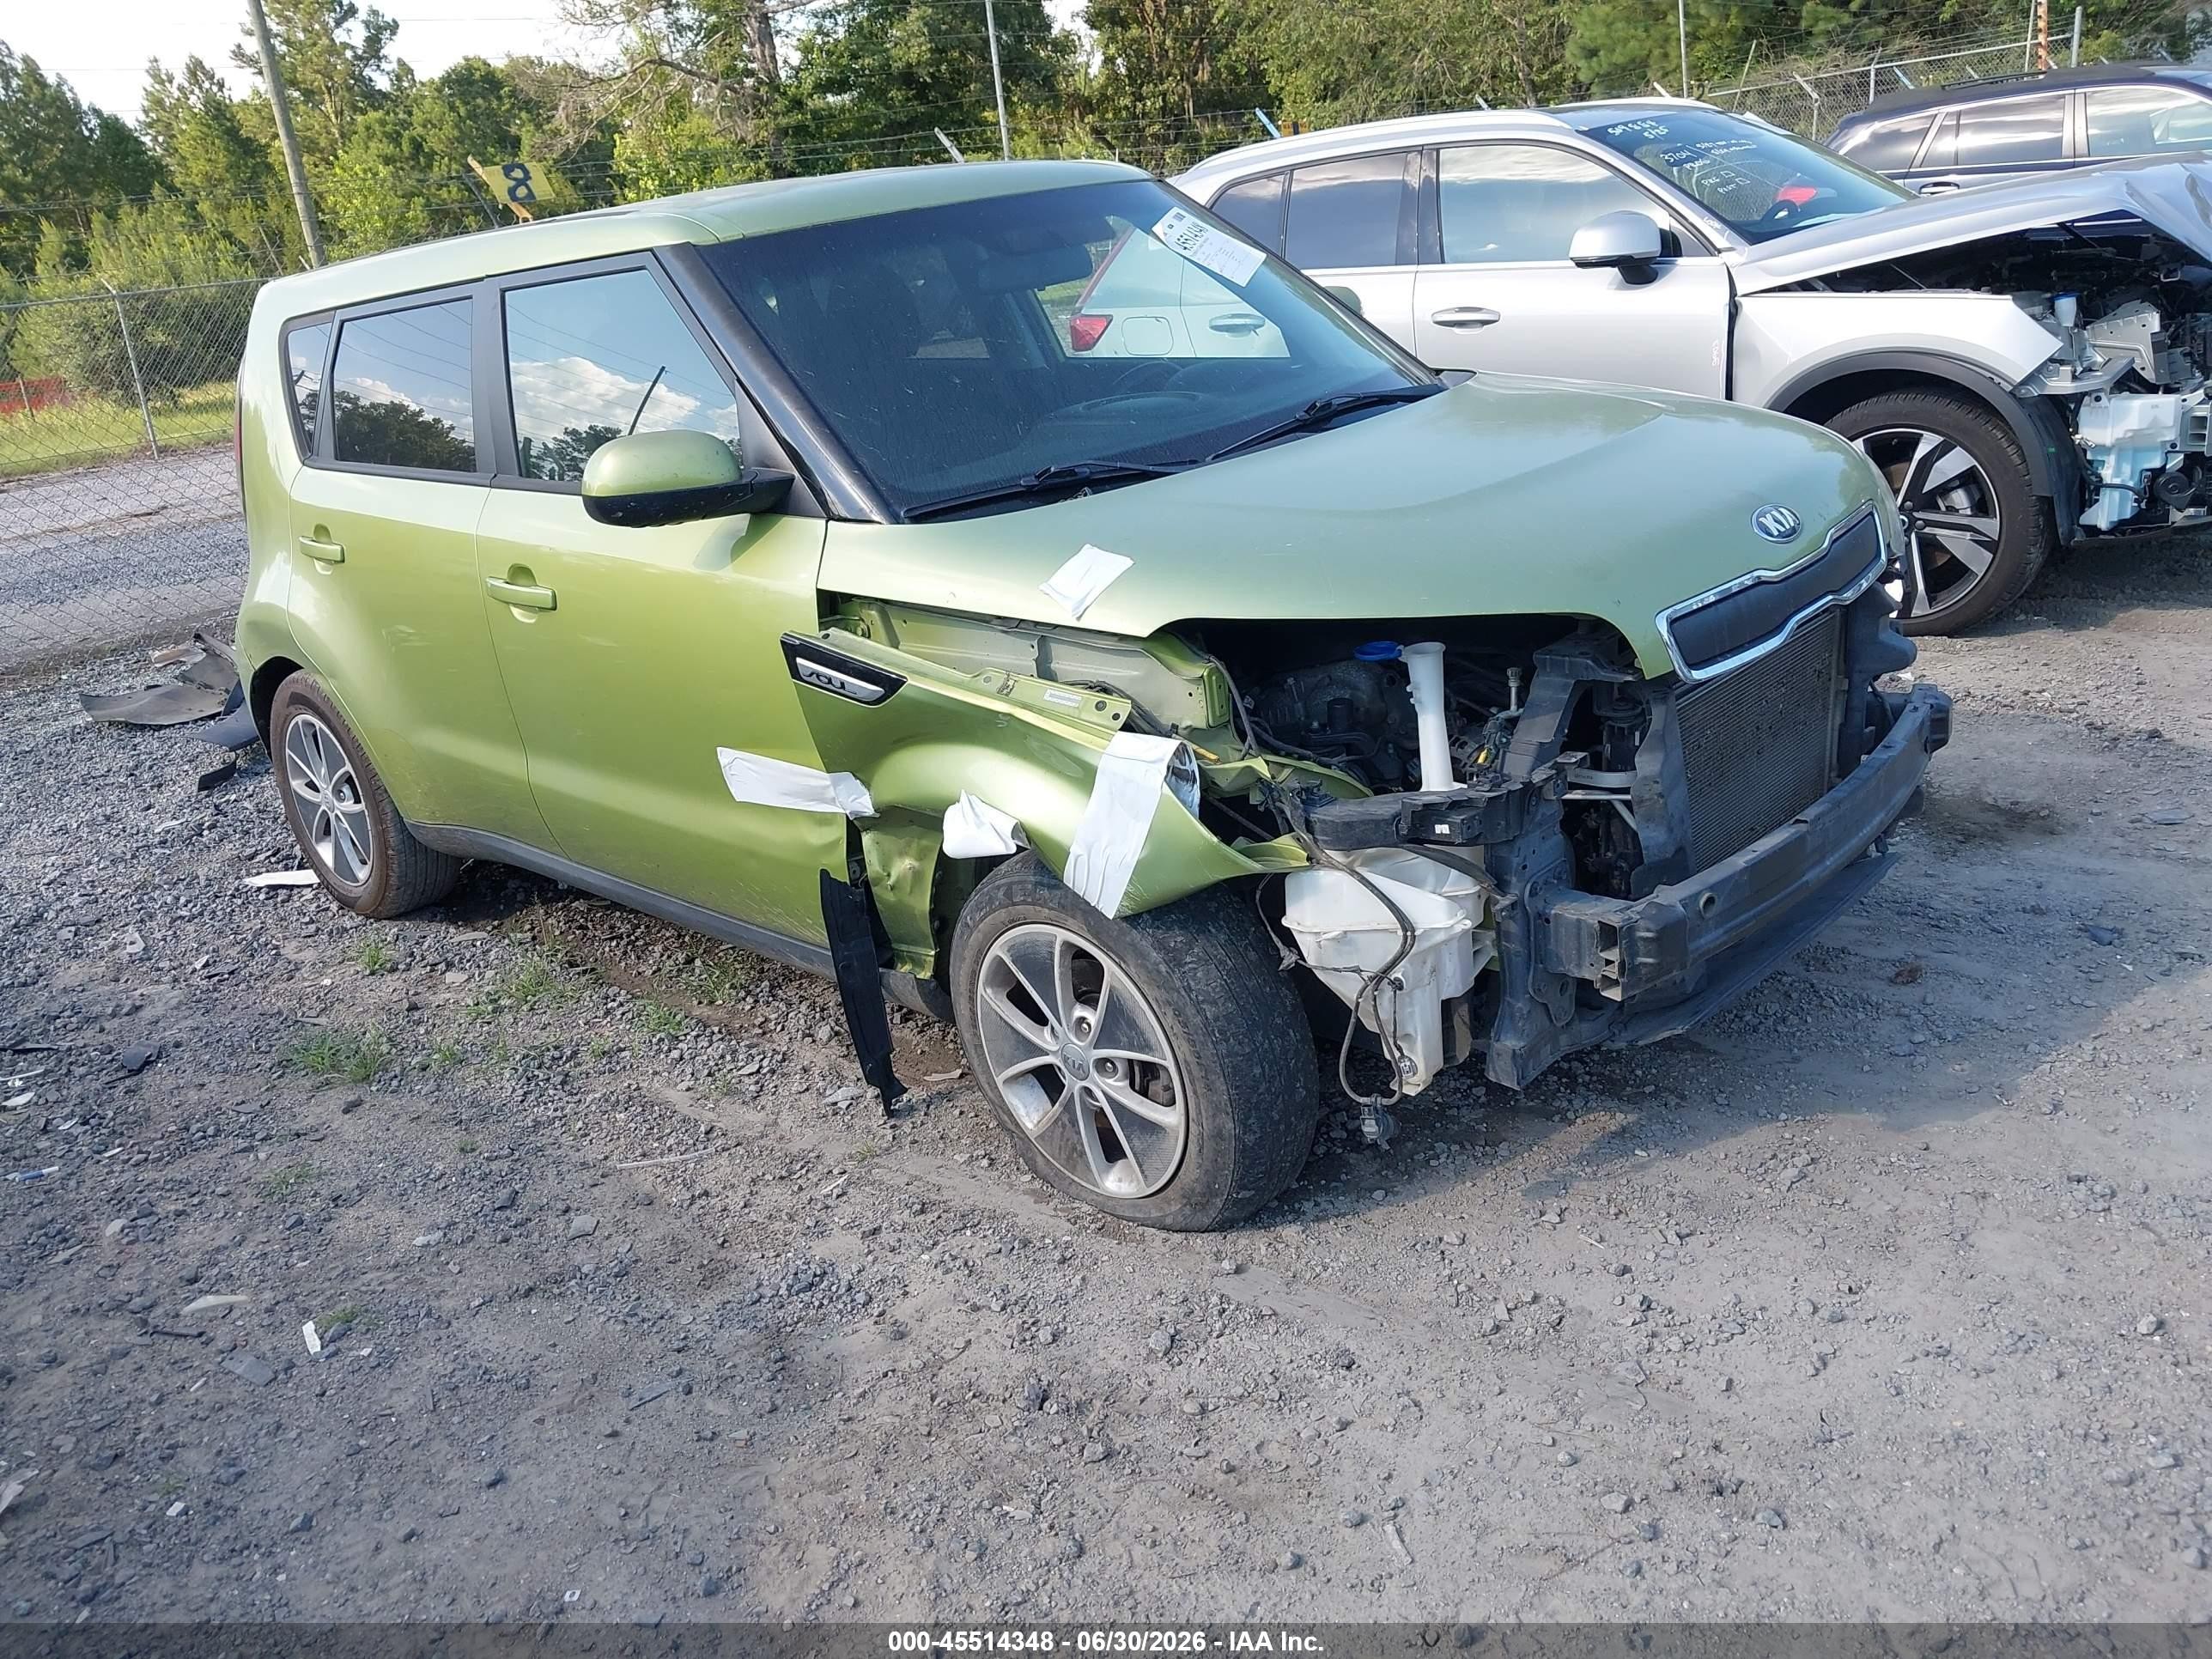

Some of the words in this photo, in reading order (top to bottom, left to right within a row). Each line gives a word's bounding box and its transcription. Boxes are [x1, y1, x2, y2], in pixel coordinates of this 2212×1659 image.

[501, 161, 537, 204] 8
[1174, 221, 1209, 252] 45514348
[1758, 507, 1800, 537] KIA
